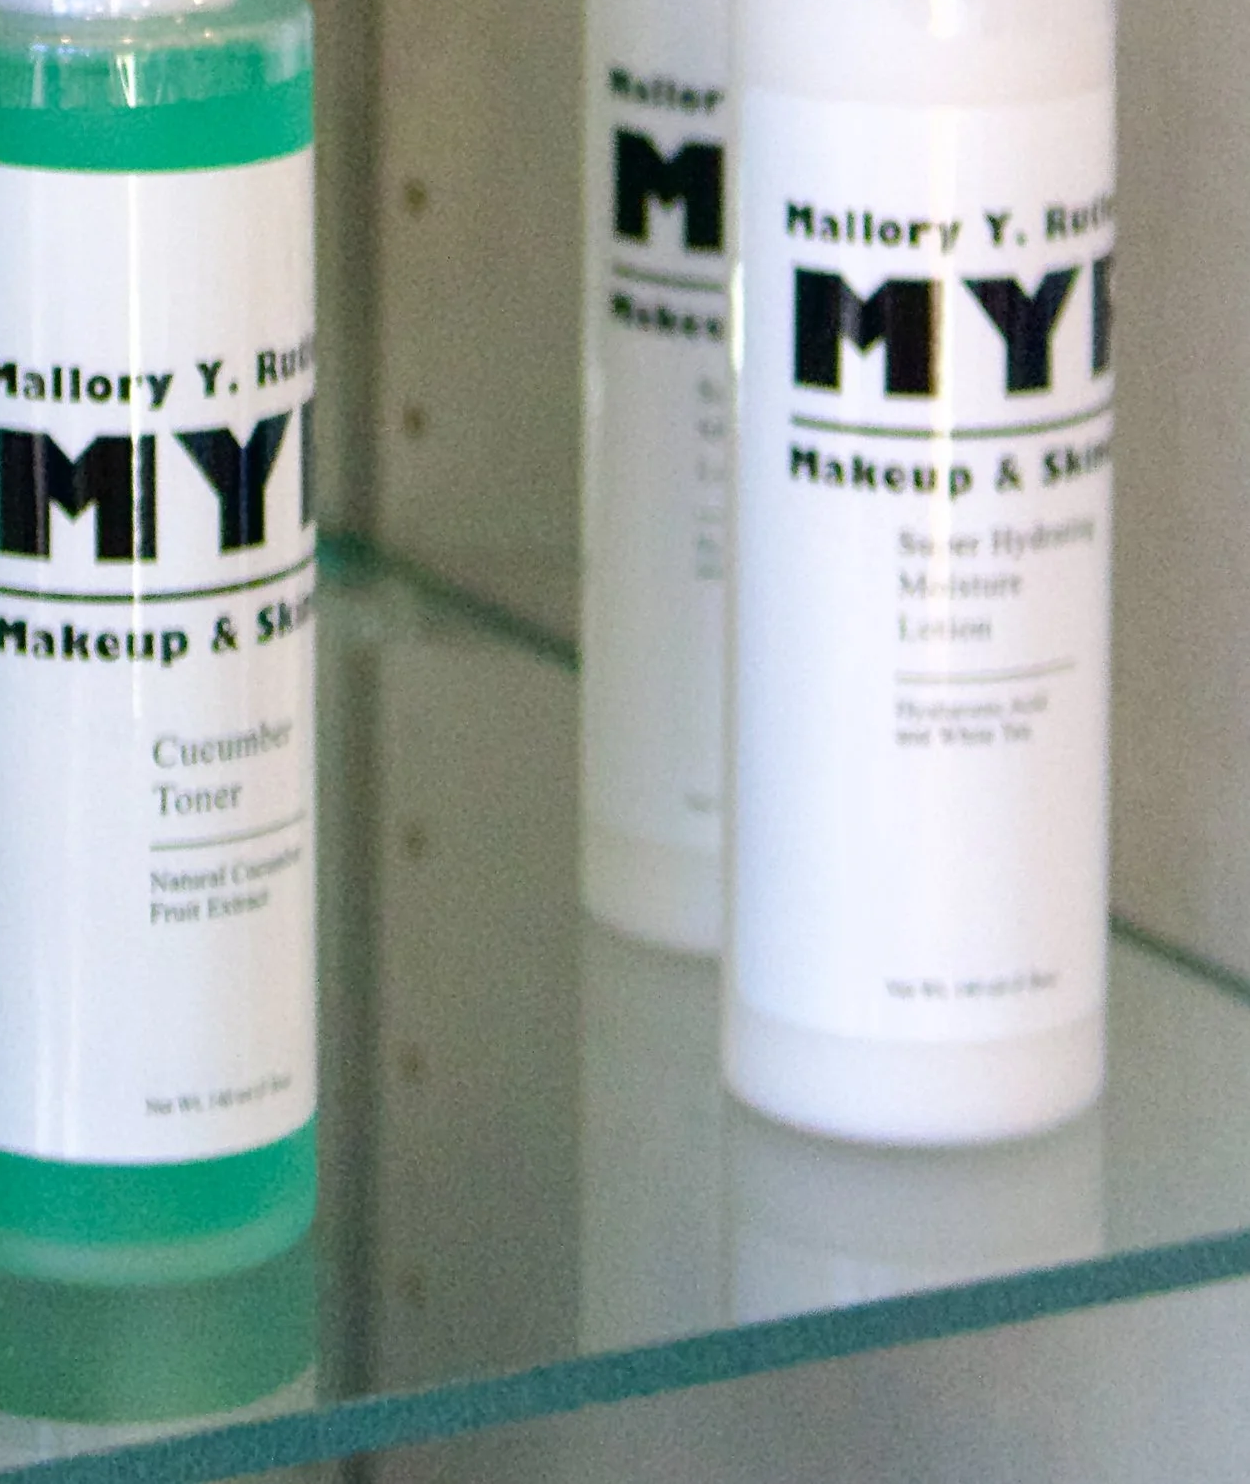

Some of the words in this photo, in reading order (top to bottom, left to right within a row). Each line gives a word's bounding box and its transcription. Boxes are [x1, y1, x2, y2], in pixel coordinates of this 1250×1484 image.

[612, 128, 724, 256] M
[787, 199, 962, 255] Mallory
[984, 208, 1028, 248] Y.
[197, 358, 239, 397] Y.
[790, 443, 973, 501] Makeup
[996, 454, 1024, 492] &
[211, 614, 238, 652] &
[150, 780, 243, 817] Toner
